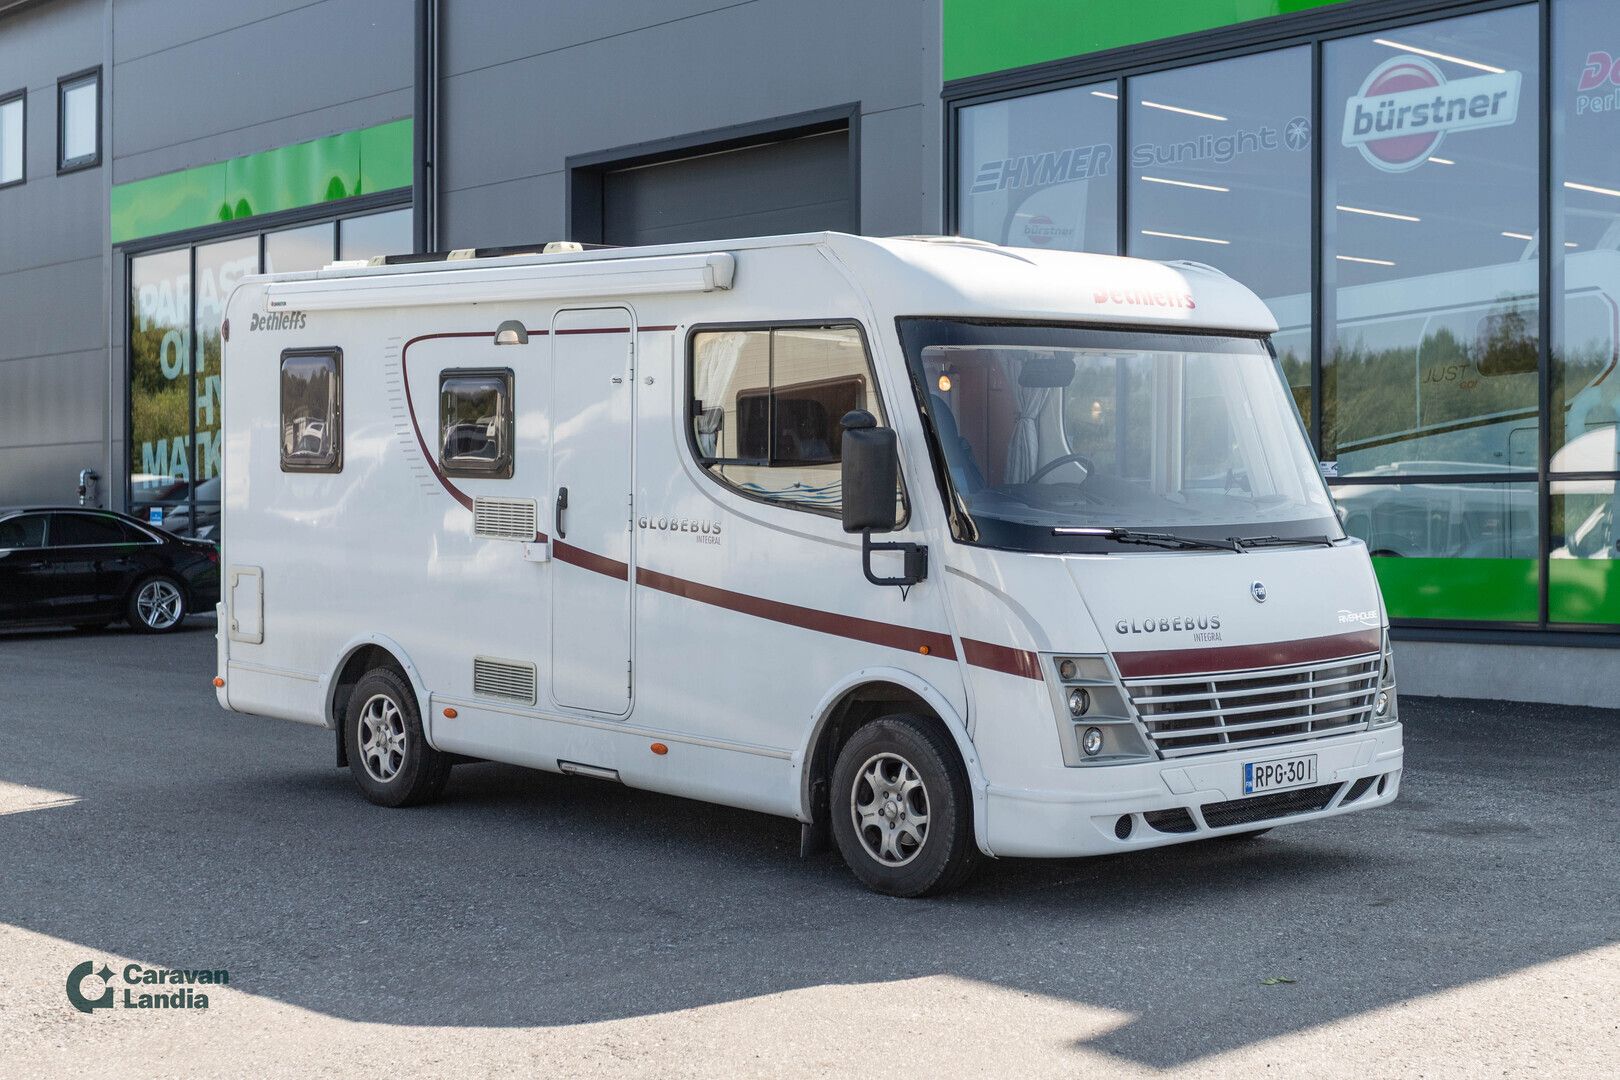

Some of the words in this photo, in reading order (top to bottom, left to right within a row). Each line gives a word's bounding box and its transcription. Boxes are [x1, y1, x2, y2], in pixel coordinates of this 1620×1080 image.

[1352, 90, 1508, 136] bürstner
[1132, 125, 1278, 168] Sunlight
[999, 143, 1113, 191] HYMER
[250, 310, 307, 331] Dethleffs
[1423, 363, 1471, 384] JUST
[638, 515, 722, 535] GLOBEBUS
[695, 535, 721, 546] INTEGRAL
[1115, 614, 1221, 634] GLOBEBUS
[1193, 631, 1222, 643] INTEGRAL
[1255, 758, 1311, 788] RPG-301
